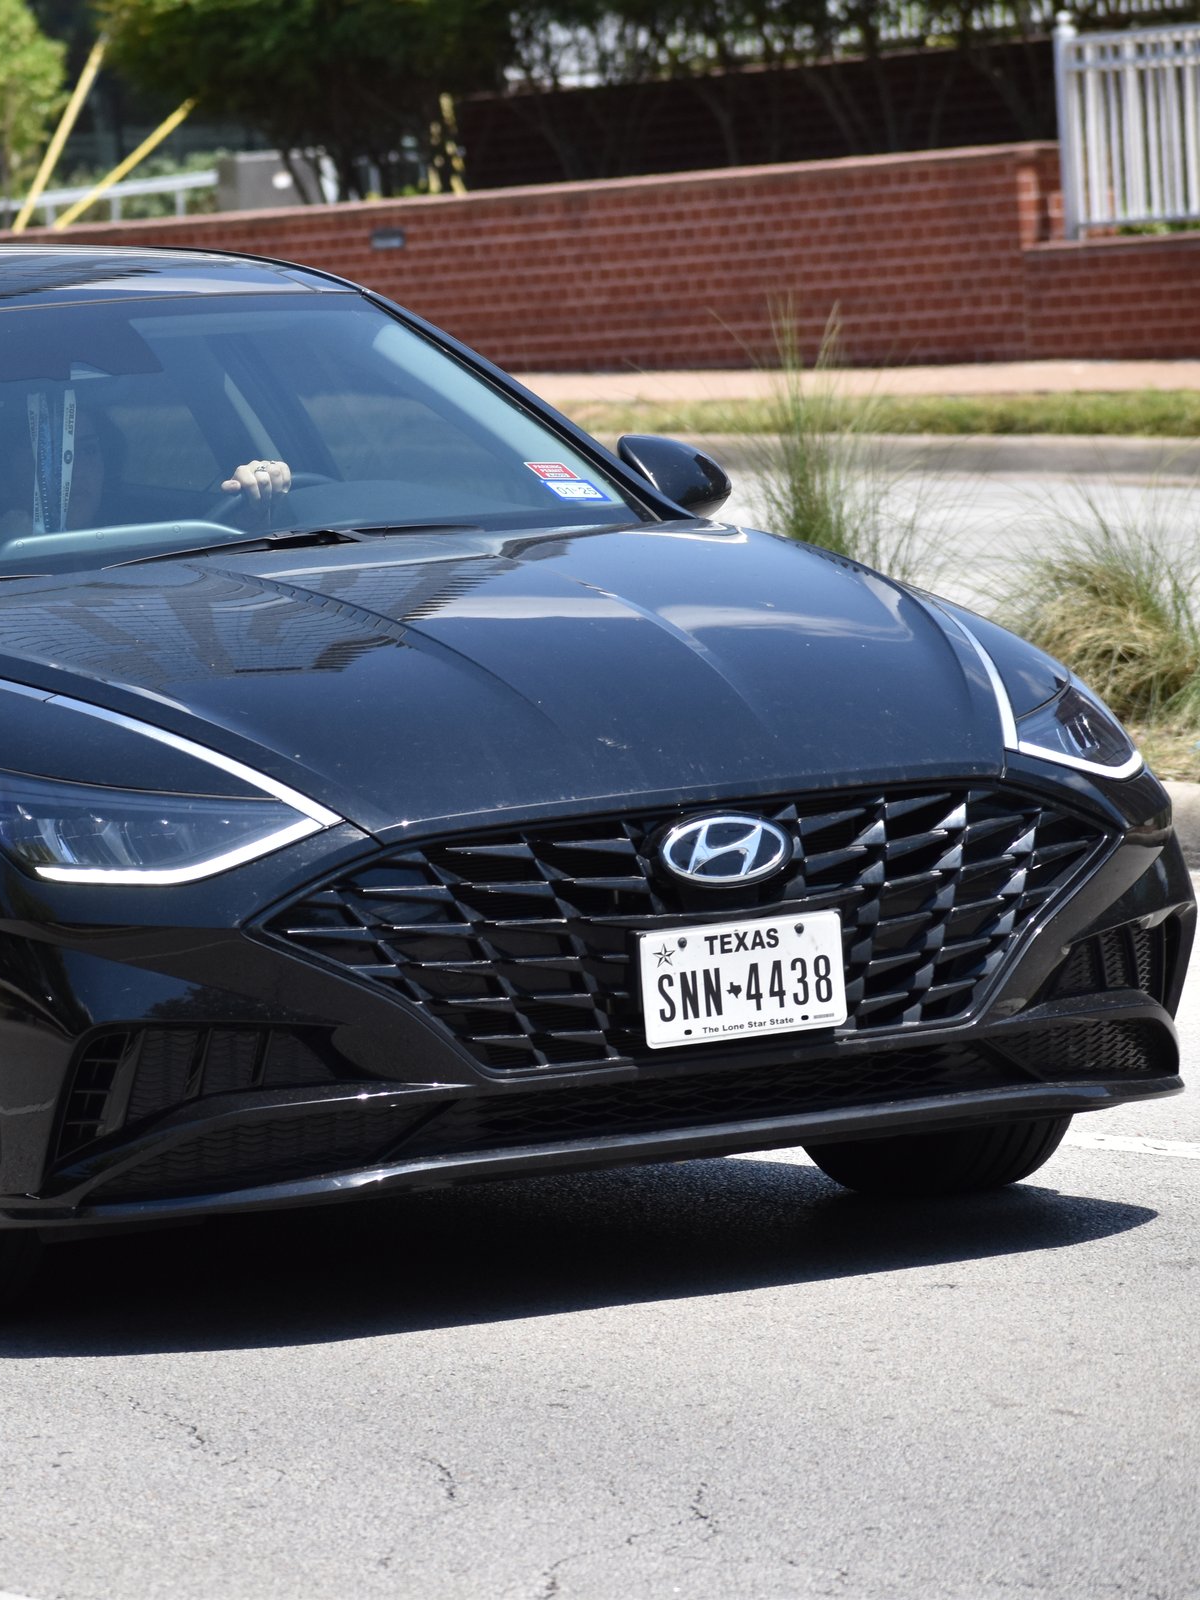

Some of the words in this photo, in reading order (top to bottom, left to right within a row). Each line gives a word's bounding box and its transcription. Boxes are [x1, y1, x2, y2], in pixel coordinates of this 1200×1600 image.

[704, 928, 780, 956] TEXAS
[657, 967, 723, 1022] SNN
[746, 954, 833, 1011] 4438
[702, 1026, 720, 1034] The
[722, 1022, 745, 1032] Lone
[747, 1019, 767, 1029] Star
[769, 1016, 795, 1026] State
